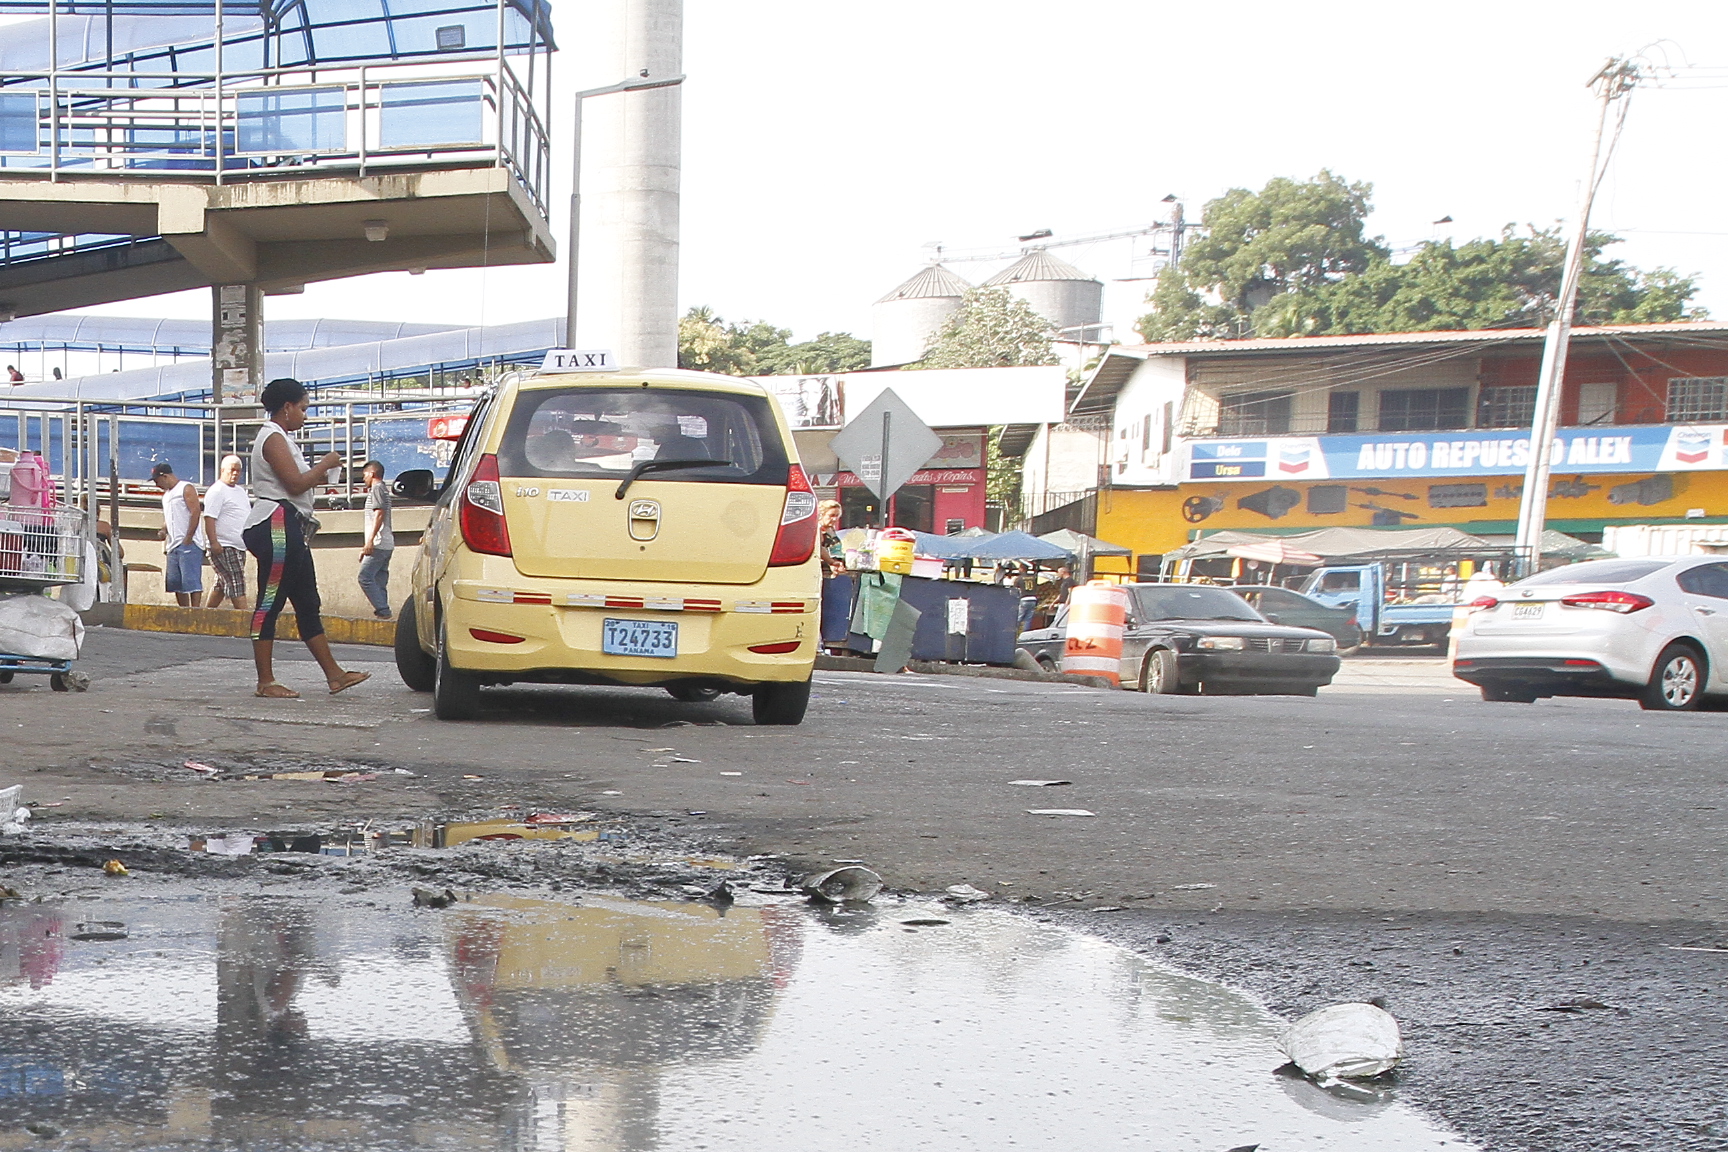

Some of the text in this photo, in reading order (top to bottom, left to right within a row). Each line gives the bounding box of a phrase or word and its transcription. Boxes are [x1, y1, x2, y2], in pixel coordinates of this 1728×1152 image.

[554, 353, 607, 368] TAXI
[1216, 445, 1243, 457] Delo
[1279, 442, 1313, 450] Chevron
[1356, 435, 1633, 471] AUTO REPUESO ALEX
[1214, 464, 1242, 476] Ursa
[516, 486, 540, 498] i10
[550, 490, 588, 501] TAXI
[1023, 580, 1033, 591] 10
[608, 627, 673, 649] T24733
[623, 647, 655, 655] PANAMA
